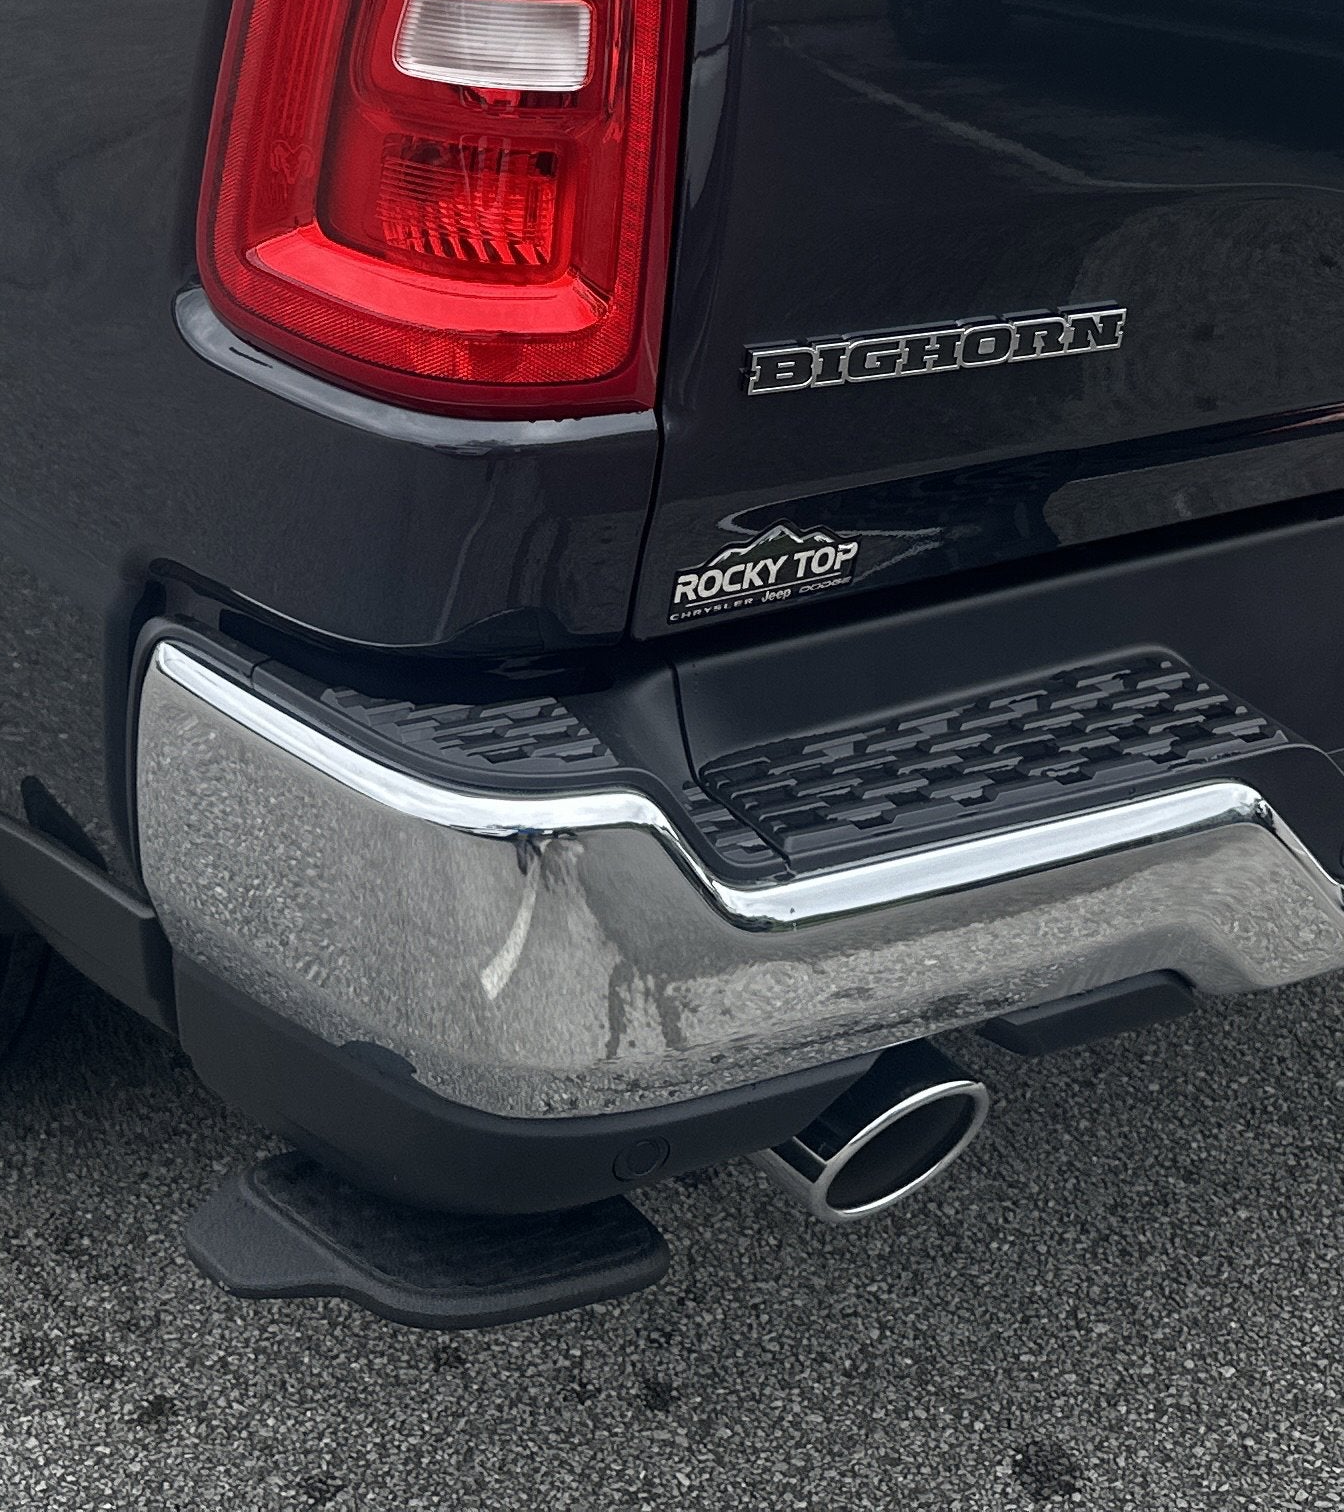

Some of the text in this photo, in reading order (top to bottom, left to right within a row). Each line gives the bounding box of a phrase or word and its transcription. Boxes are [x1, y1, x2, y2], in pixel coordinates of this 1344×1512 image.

[744, 300, 1128, 396] BIGHORN
[673, 541, 859, 604] ROCKY TOP
[669, 597, 755, 622] CHRYSLER
[761, 588, 792, 603] Jeep
